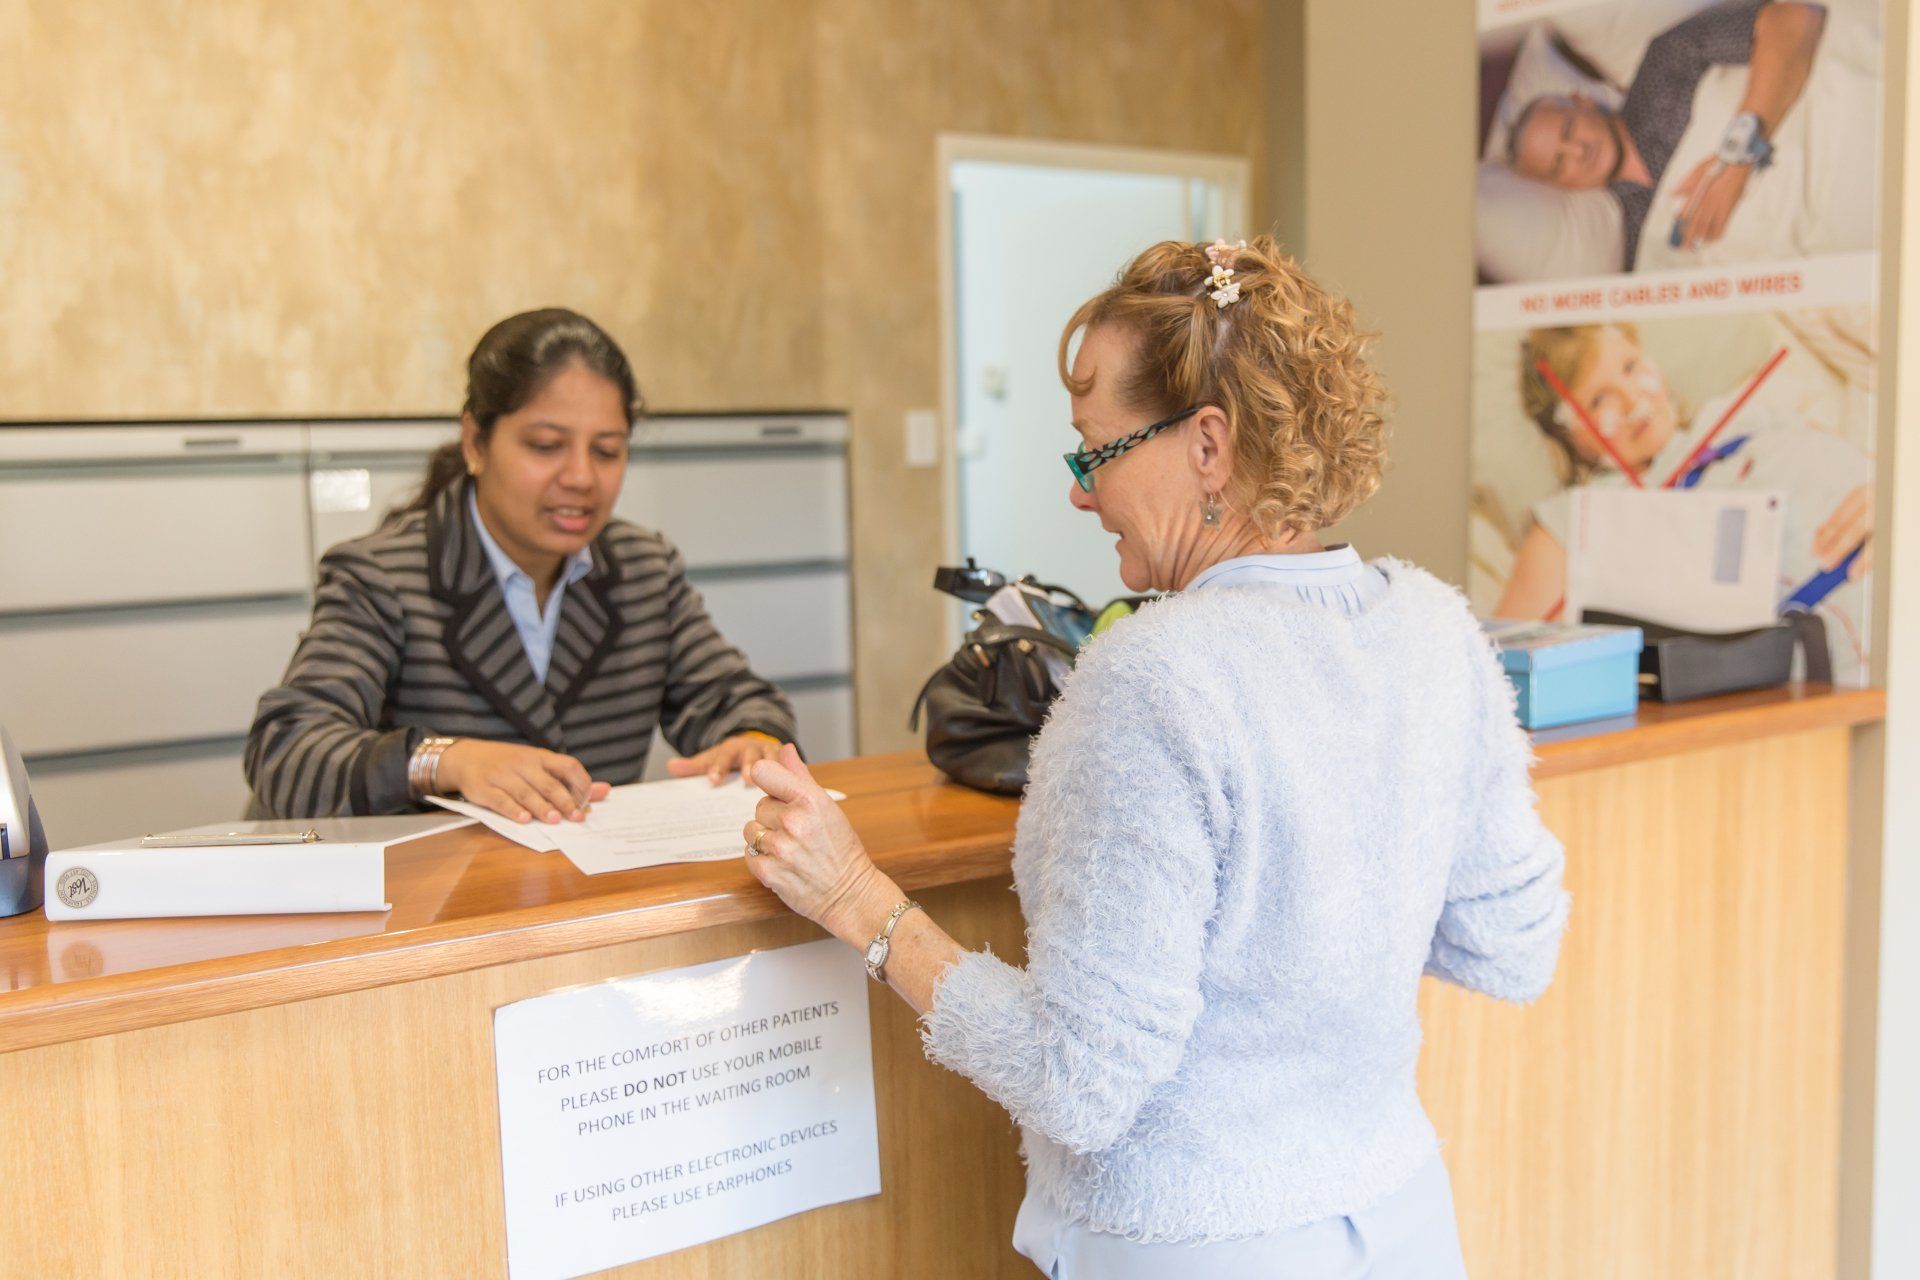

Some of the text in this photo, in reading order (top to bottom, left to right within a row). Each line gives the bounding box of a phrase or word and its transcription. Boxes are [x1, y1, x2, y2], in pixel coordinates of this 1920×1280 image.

[1521, 272, 1803, 315] NO MORE CABLES AND WIRES
[538, 1001, 839, 1083] FOR THE COMFORT OF OTHER PATIENTS
[561, 1036, 823, 1111] PLEASE DO NOT USE YOUR MOBILE
[578, 1066, 810, 1136] PHONE IN THE WAITING ROOM
[555, 1120, 837, 1208] IF USING OTHER ELECTRONIC DEVICES
[613, 1160, 792, 1221] PLEASE USE EARPHONES
